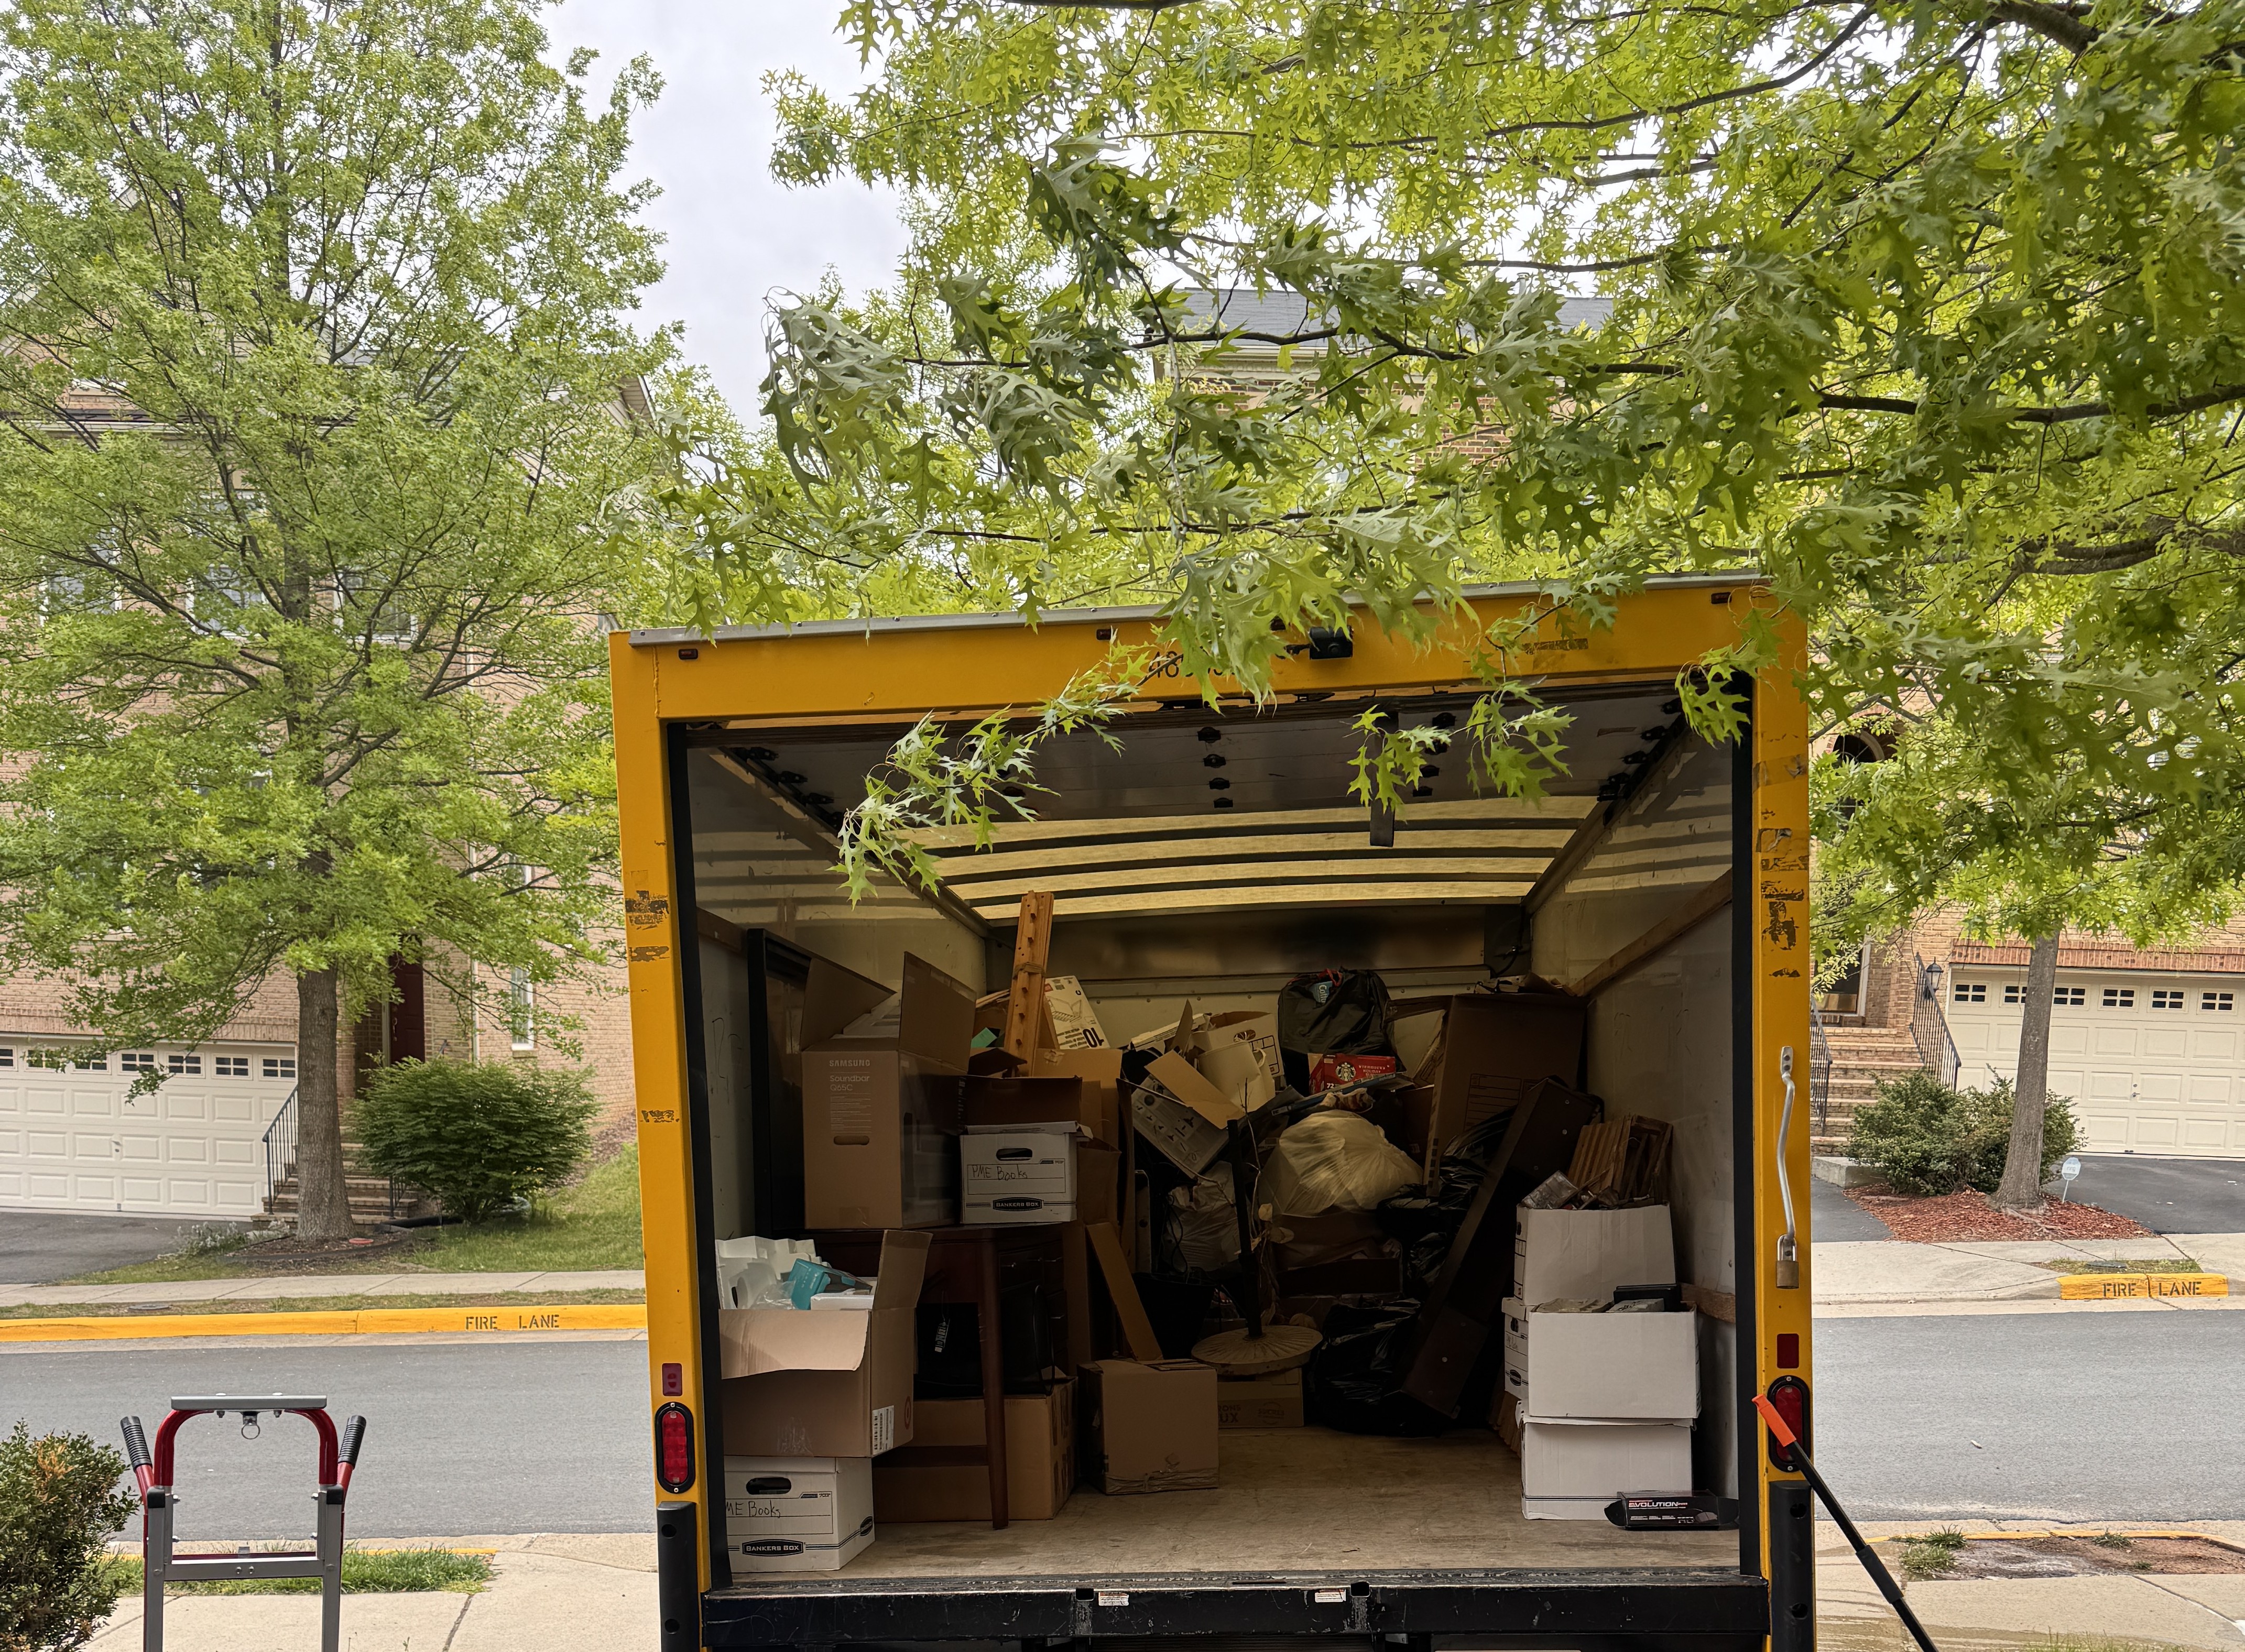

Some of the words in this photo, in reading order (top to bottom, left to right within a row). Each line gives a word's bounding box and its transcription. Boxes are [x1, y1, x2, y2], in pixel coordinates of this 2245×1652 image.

[1083, 1027, 1104, 1048] 10
[973, 1165, 991, 1178] PME
[997, 1164, 1028, 1181] Books
[2103, 1282, 2137, 1297] FIRE
[2159, 1281, 2202, 1296] LANE
[466, 1316, 498, 1330] FIRE
[519, 1314, 560, 1329] LANE
[748, 1500, 781, 1518] Books
